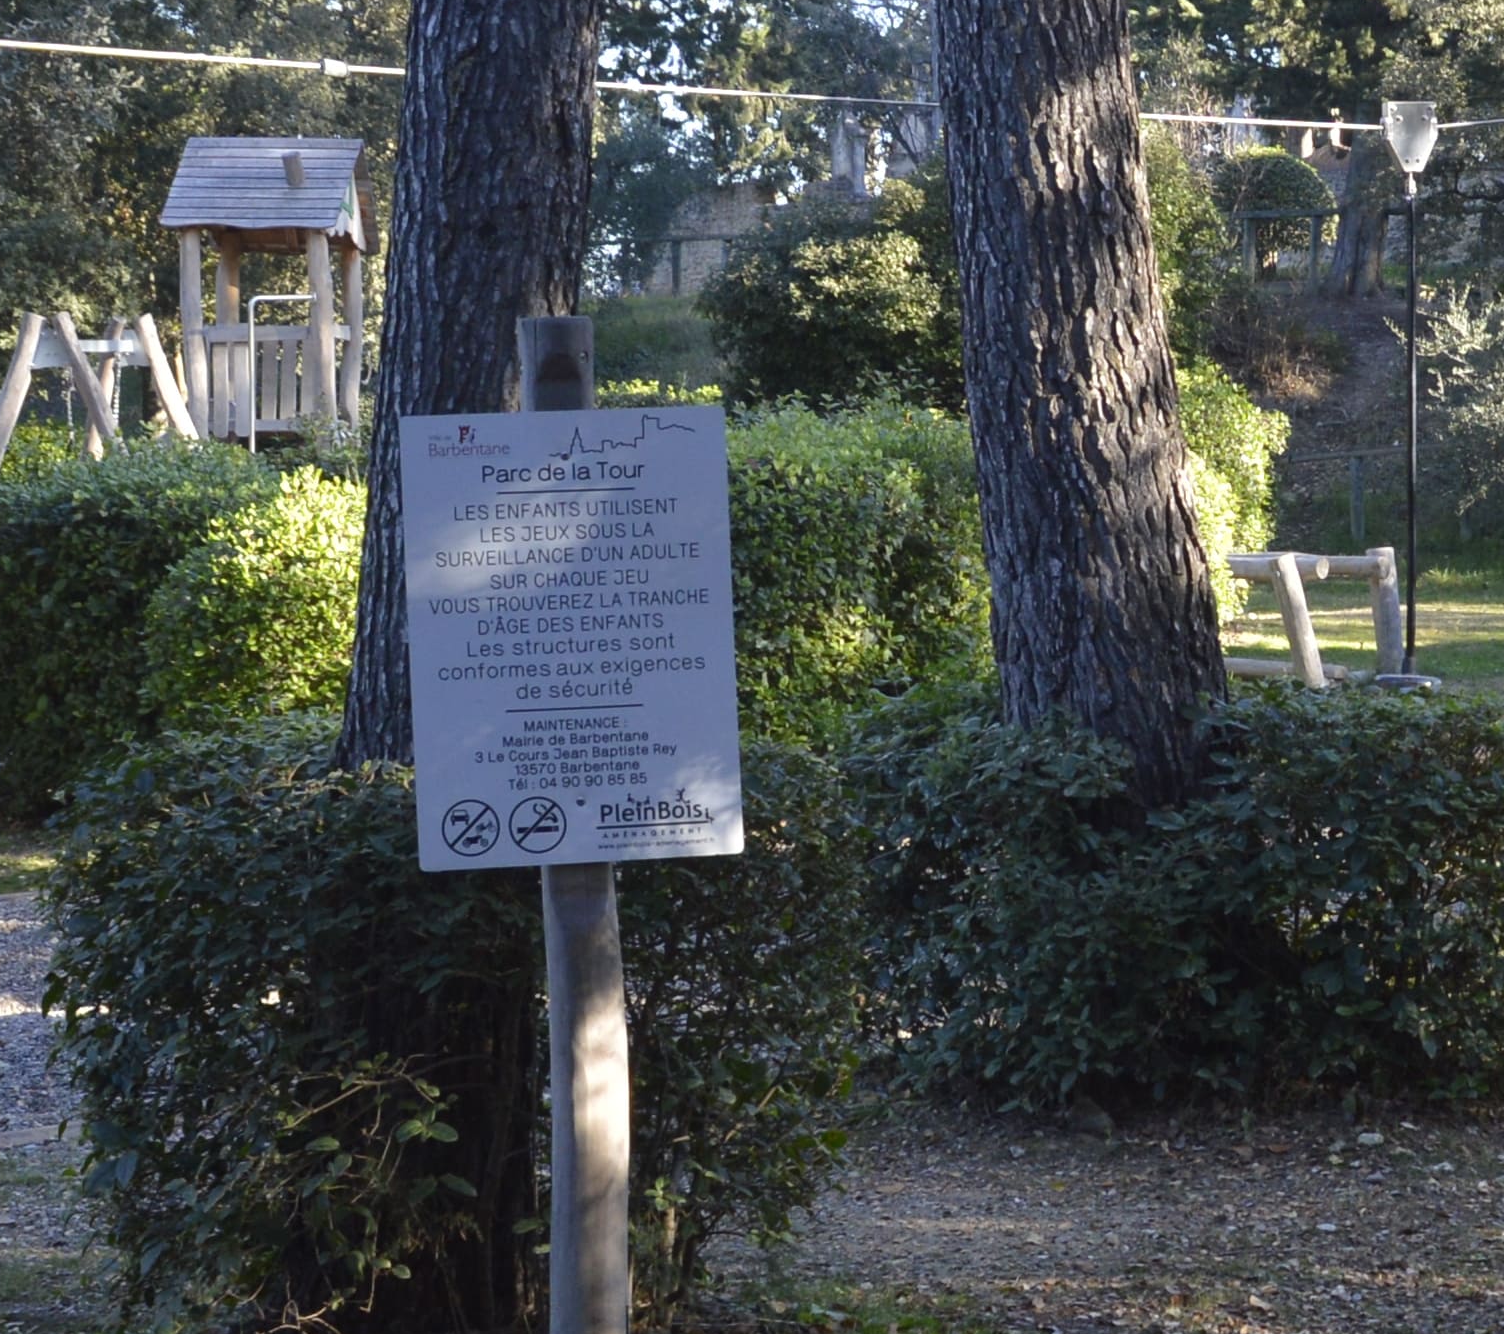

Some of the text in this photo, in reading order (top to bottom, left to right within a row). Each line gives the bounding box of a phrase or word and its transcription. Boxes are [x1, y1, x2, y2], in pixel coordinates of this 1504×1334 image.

[428, 443, 510, 458] Barbentane
[482, 462, 645, 483] Parc de la Tour
[454, 498, 678, 521] LES ENFANTS UTILISENT
[480, 523, 654, 543] LES JEUX SOUS LA
[436, 542, 700, 567] SURVEILLANCE D'UN ADULTE
[490, 570, 649, 589] SUR CHAQUE JEU
[430, 589, 709, 615] VOUS TROUVEREZ LA TRANCHE
[478, 612, 664, 635] D'ÂGE DES ENFANTS
[467, 633, 674, 657] Les structures sont
[438, 653, 705, 682] conformes aux exigences
[516, 678, 633, 700] de sécurité
[524, 717, 620, 732] MAINTENANCE
[503, 730, 649, 748] Mairie de Barbentane
[475, 742, 677, 764] 3 Le Cours Jean Baptiste Rey
[515, 759, 640, 776] 13570 Barbentane
[509, 777, 528, 791] Tél
[539, 775, 558, 788] 04
[562, 775, 581, 787] 90
[585, 773, 603, 786] 90
[608, 772, 625, 785] 85
[630, 772, 647, 784] 85
[600, 801, 702, 823] PleinBois
